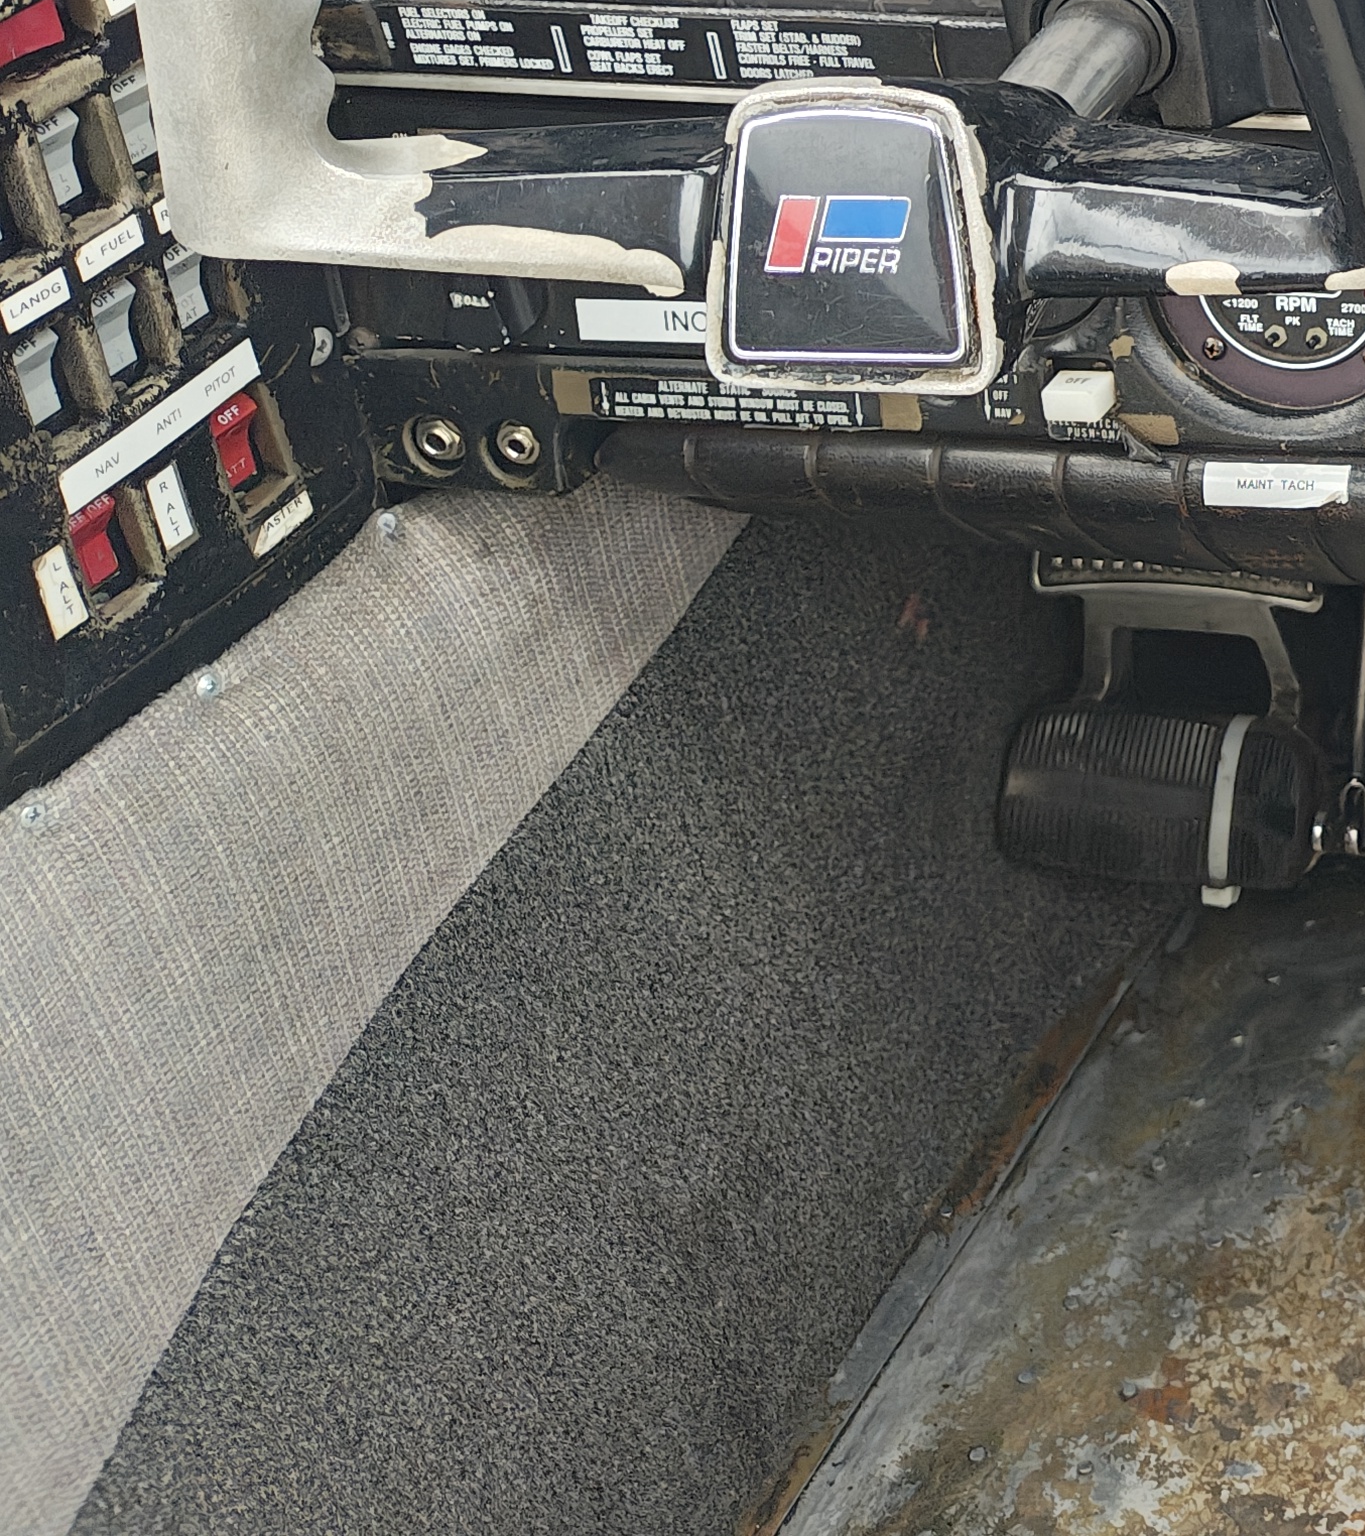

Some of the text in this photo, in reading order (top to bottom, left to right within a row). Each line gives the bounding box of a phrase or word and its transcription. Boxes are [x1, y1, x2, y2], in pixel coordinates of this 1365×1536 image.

[810, 246, 902, 275] PIPER
[9, 281, 62, 319] LANDG
[204, 366, 237, 398] PITOT
[1236, 478, 1315, 491] MAINT TACH
